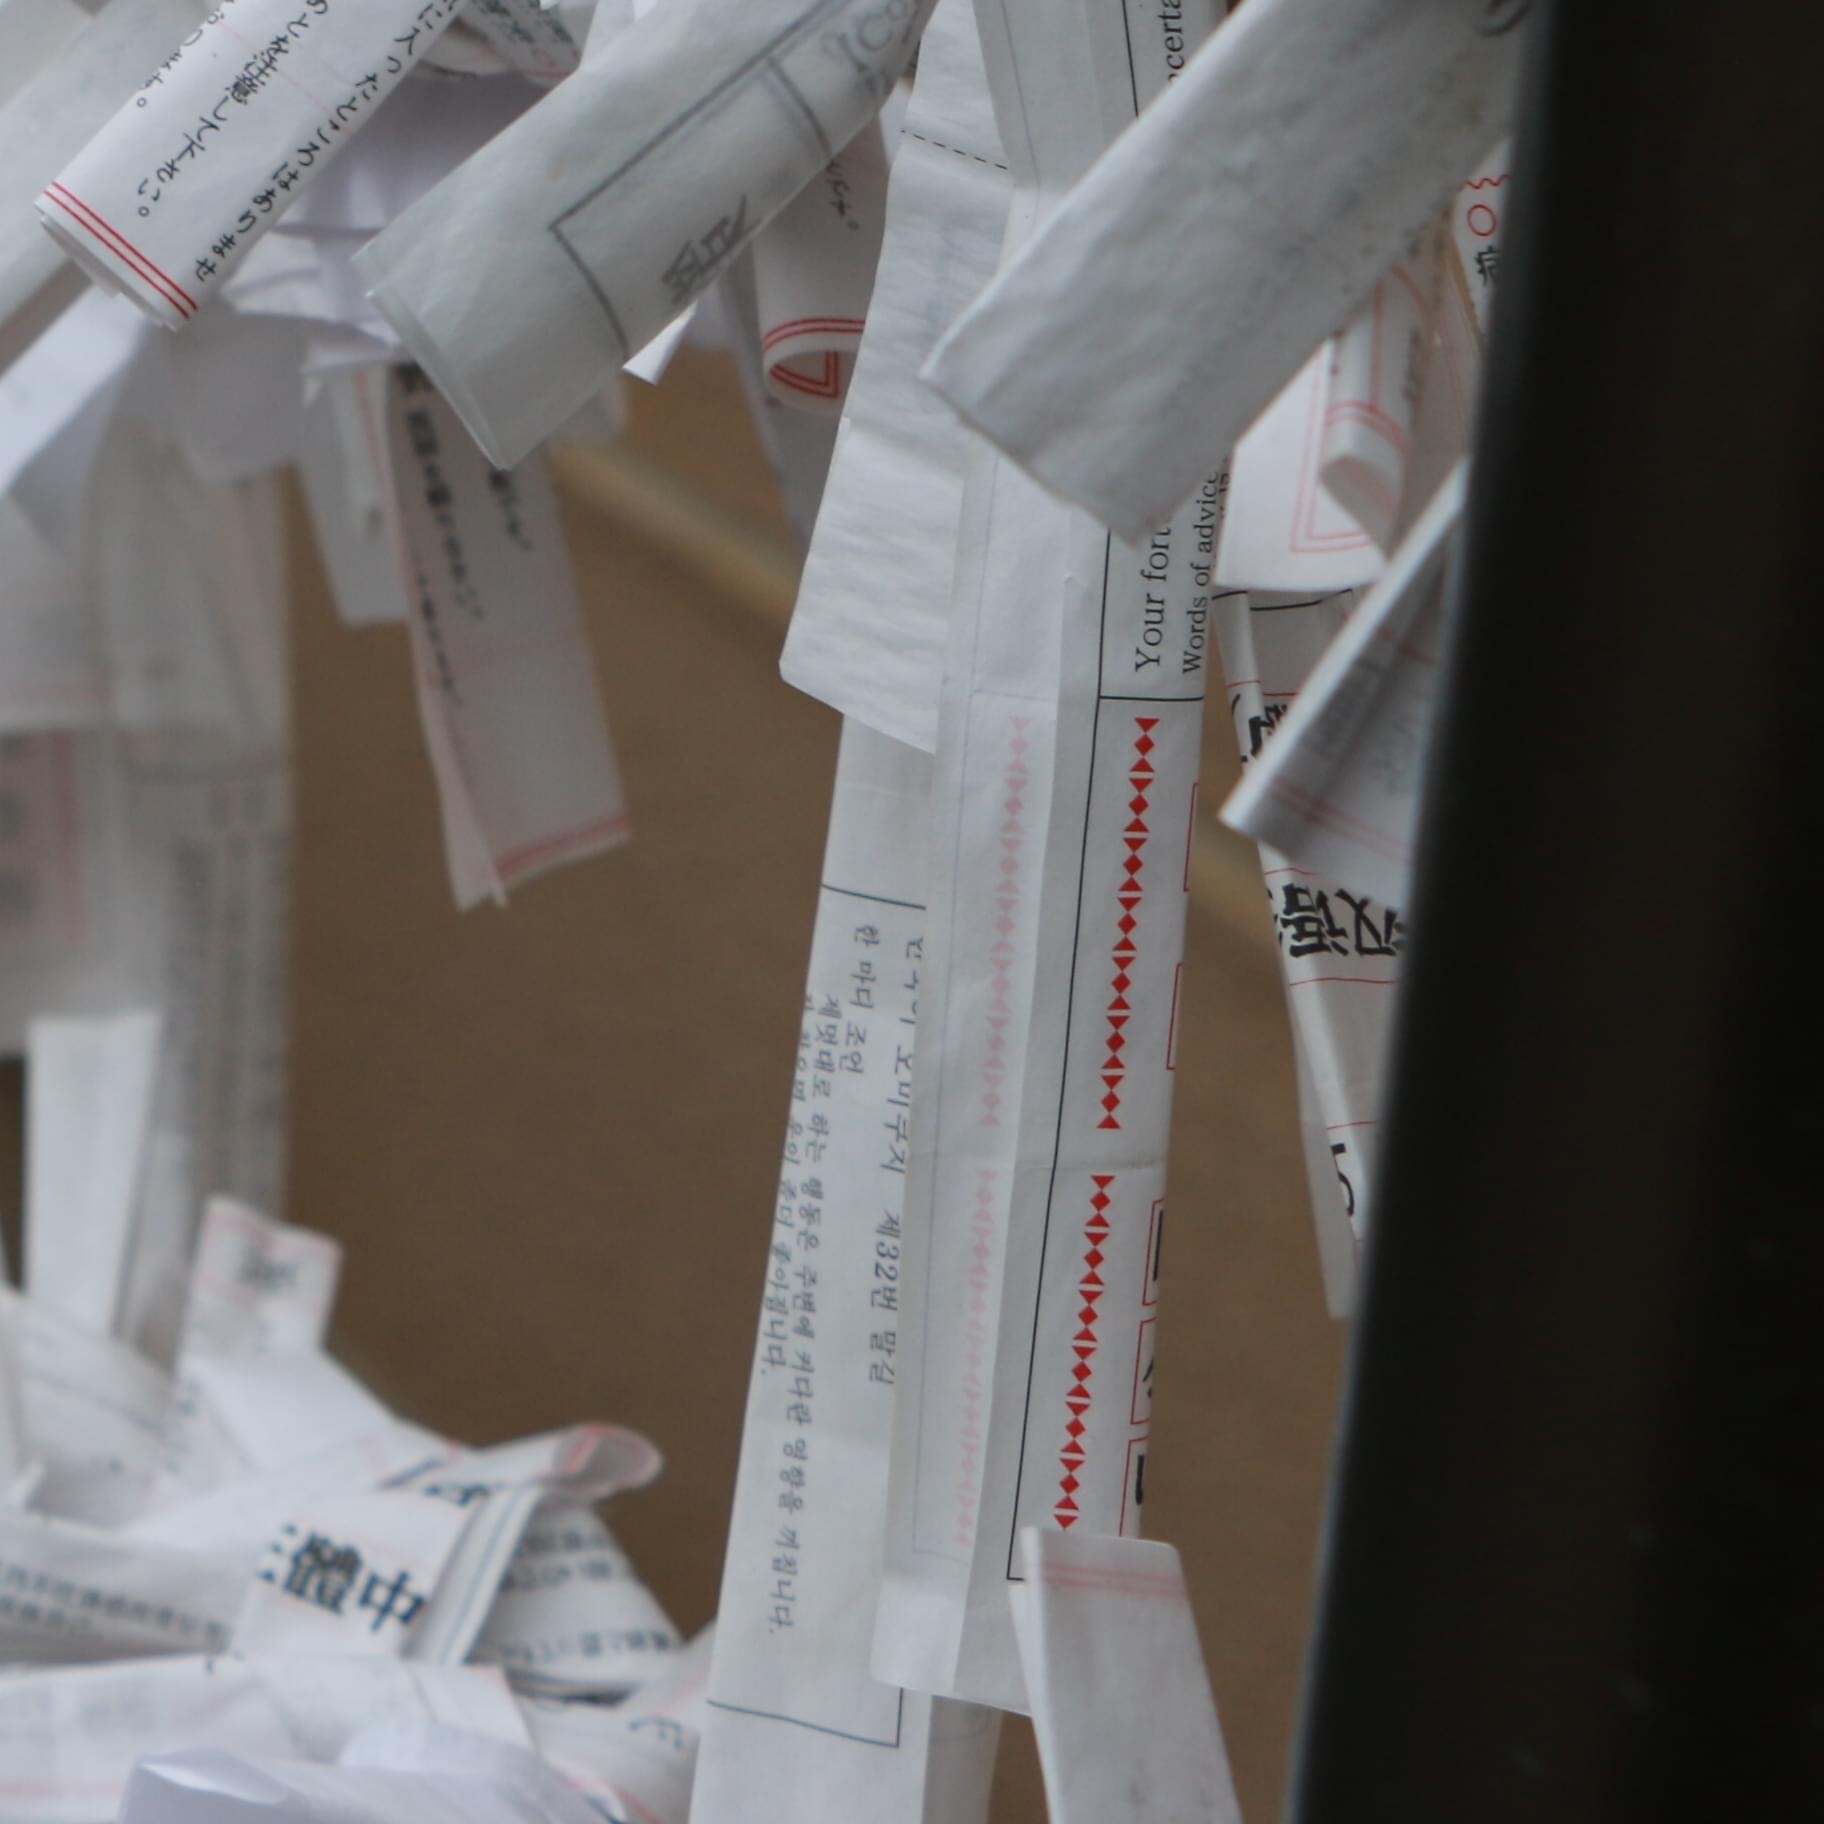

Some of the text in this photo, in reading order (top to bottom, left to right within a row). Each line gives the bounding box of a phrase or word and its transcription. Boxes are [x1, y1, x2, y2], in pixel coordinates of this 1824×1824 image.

[1189, 561, 1212, 587] of
[1134, 592, 1166, 673] Your
[1181, 595, 1209, 674] Words
[839, 924, 880, 1075] 한 마디 조언
[870, 1209, 902, 1312] 제32번
[767, 991, 843, 1637] 제멋대로 하는 행동은 주변에 커다란 영향을 끼칩니다.
[868, 1329, 898, 1386] 말길
